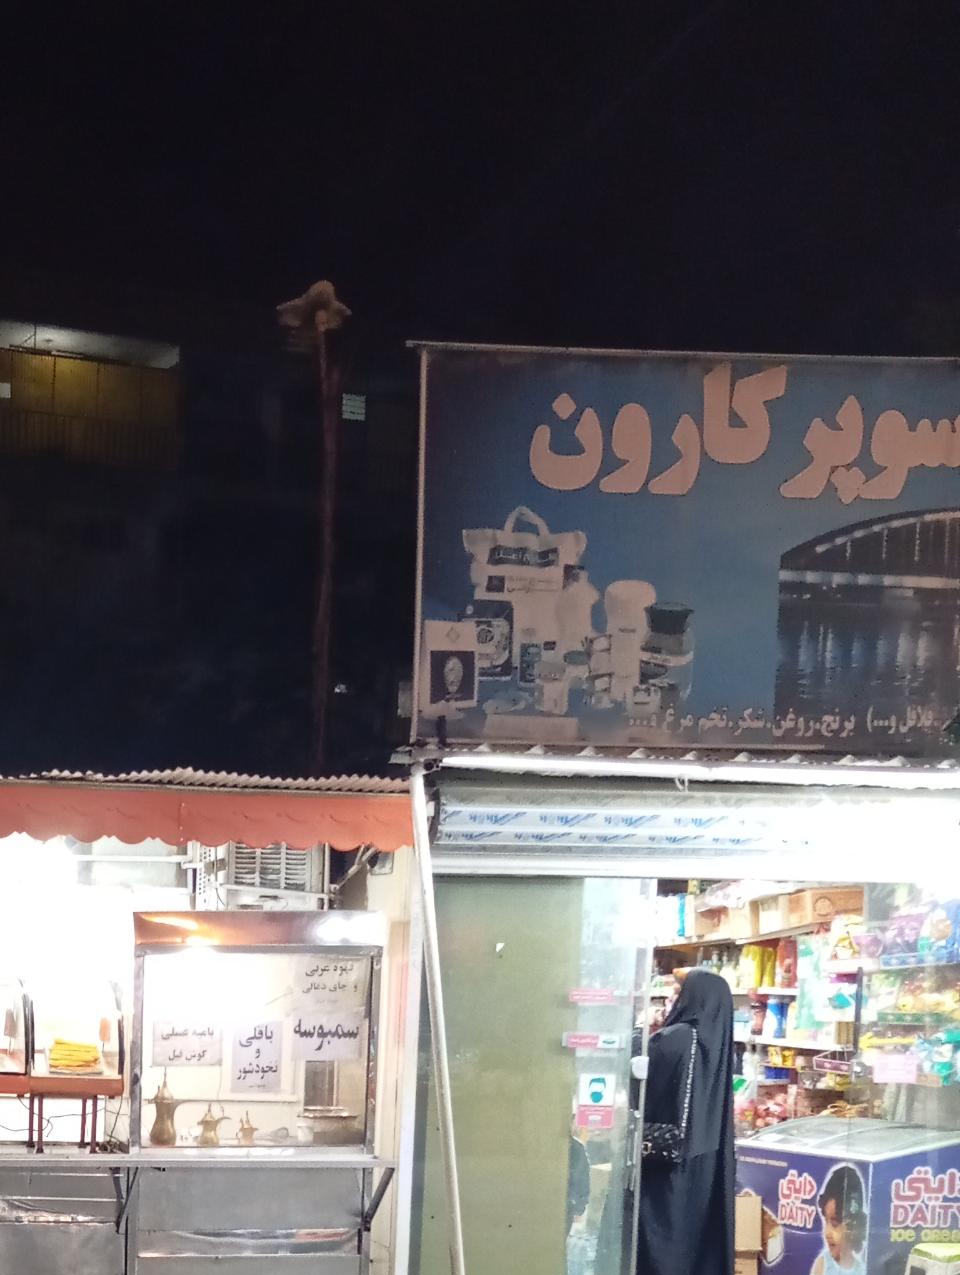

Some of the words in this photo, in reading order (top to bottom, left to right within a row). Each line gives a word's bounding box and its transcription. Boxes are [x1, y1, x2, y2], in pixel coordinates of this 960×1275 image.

[529, 362, 788, 496] کارون
[780, 395, 960, 505] سوپر
[239, 1024, 274, 1048] باقلی
[293, 1018, 360, 1051] سمبوسه
[779, 1170, 817, 1202] دایتی
[778, 1200, 816, 1228] DAITY
